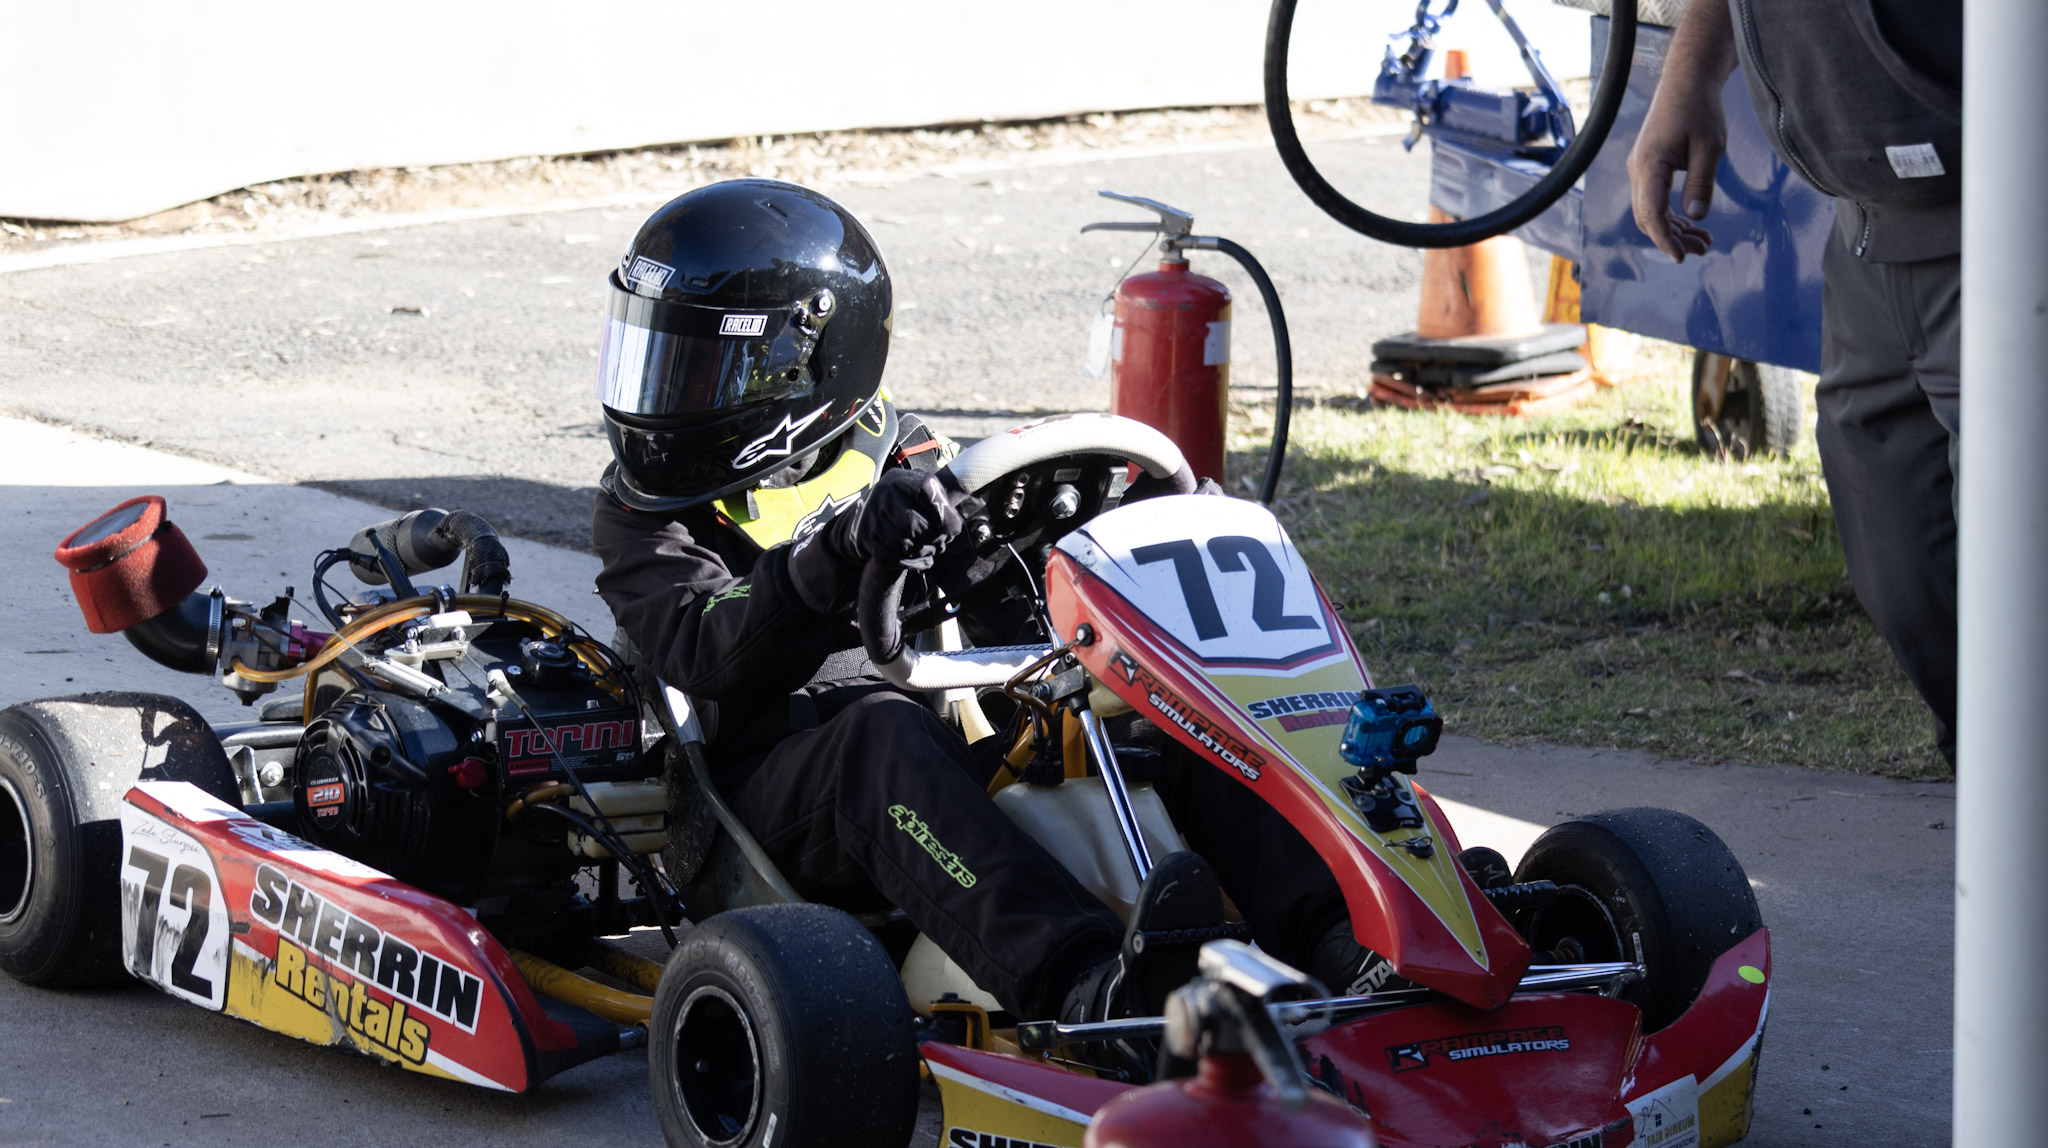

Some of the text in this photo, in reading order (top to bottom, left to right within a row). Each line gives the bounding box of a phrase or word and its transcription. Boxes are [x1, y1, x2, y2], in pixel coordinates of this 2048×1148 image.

[1131, 535, 1322, 641] 72
[504, 719, 635, 759] TORINI
[1148, 693, 1261, 781] SIMULATORS
[1276, 707, 1350, 733] Rental
[310, 777, 339, 785] CLUBMAXX
[313, 786, 341, 803] 210
[128, 845, 213, 1000] 72
[250, 863, 485, 1035] SHERRIN
[275, 935, 431, 1065] Rentals
[1448, 1038, 1570, 1061] SIMULATORS
[1647, 1114, 1695, 1148] FAIR DINKUM
